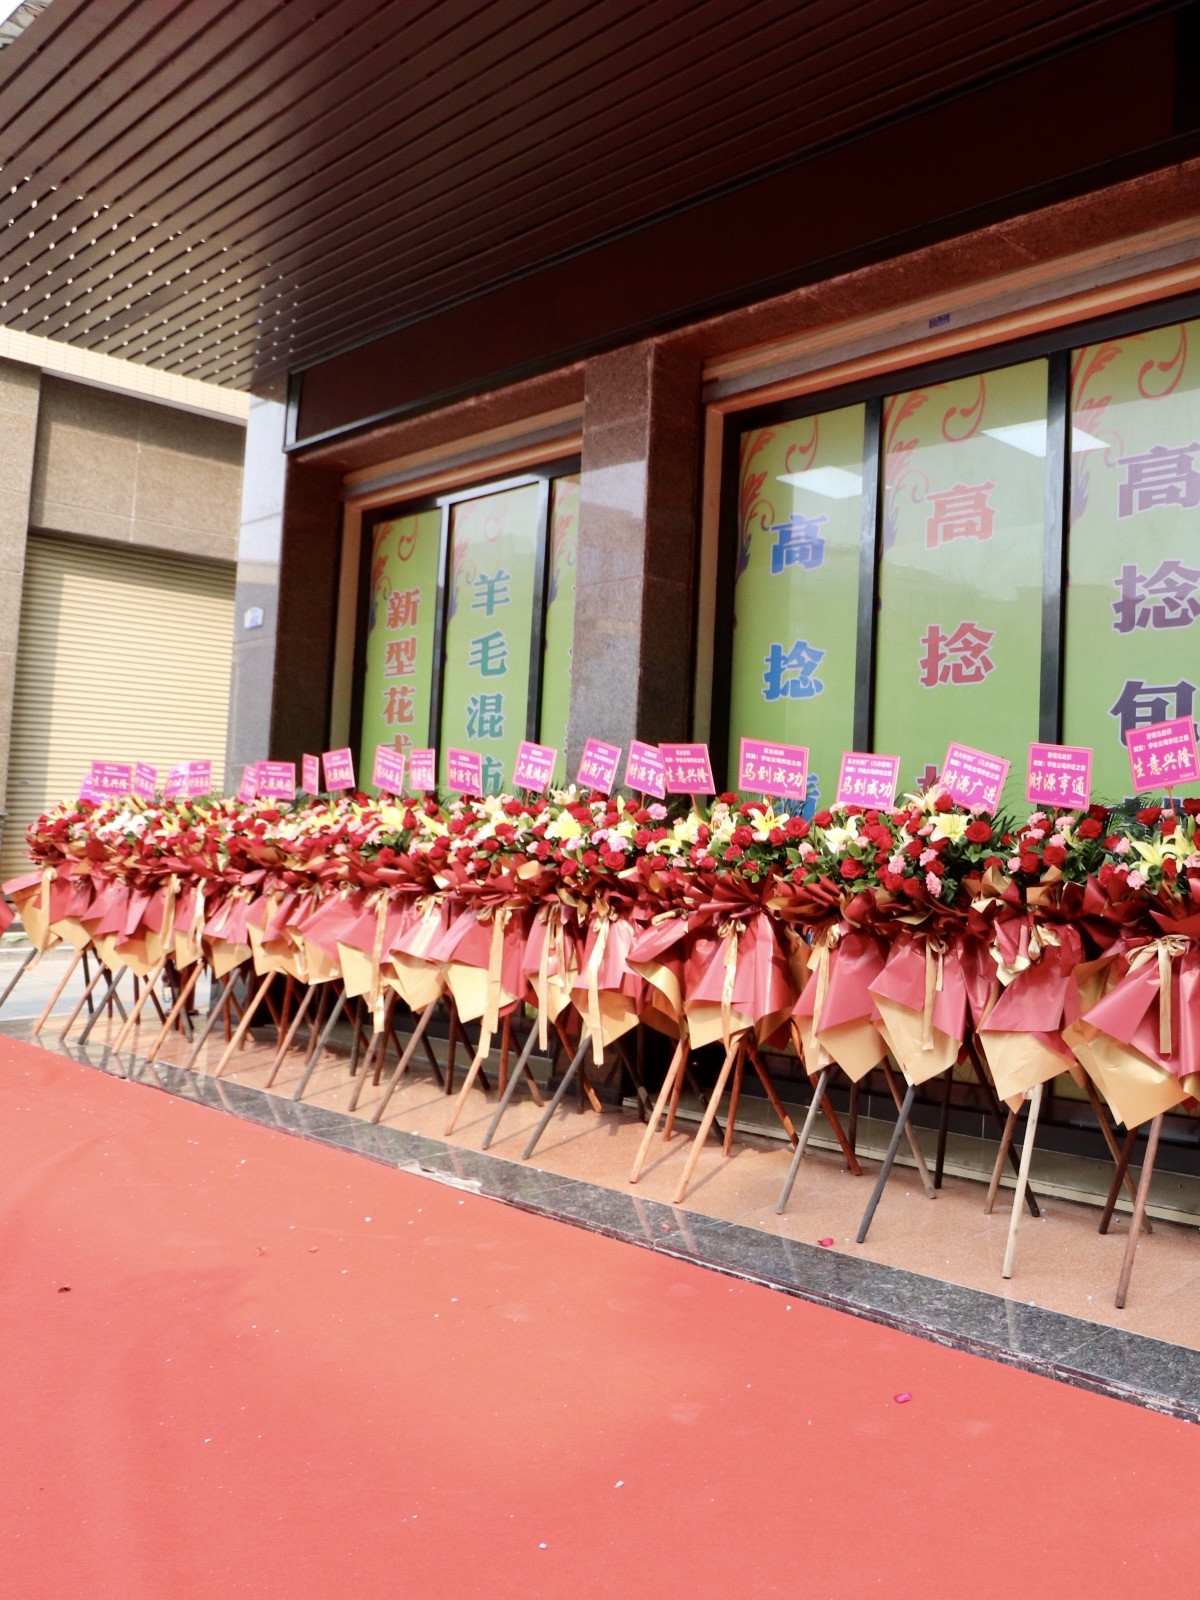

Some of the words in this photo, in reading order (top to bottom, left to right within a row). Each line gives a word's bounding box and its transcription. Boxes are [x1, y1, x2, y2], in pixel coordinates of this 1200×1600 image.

[666, 765, 710, 784] 生意兴隆
[742, 762, 804, 788] 马到成功
[1133, 746, 1195, 779] 生意兴隆
[840, 775, 893, 800] 马到成功
[943, 769, 996, 804] 财源广进
[1028, 770, 1087, 797] 财源亨通
